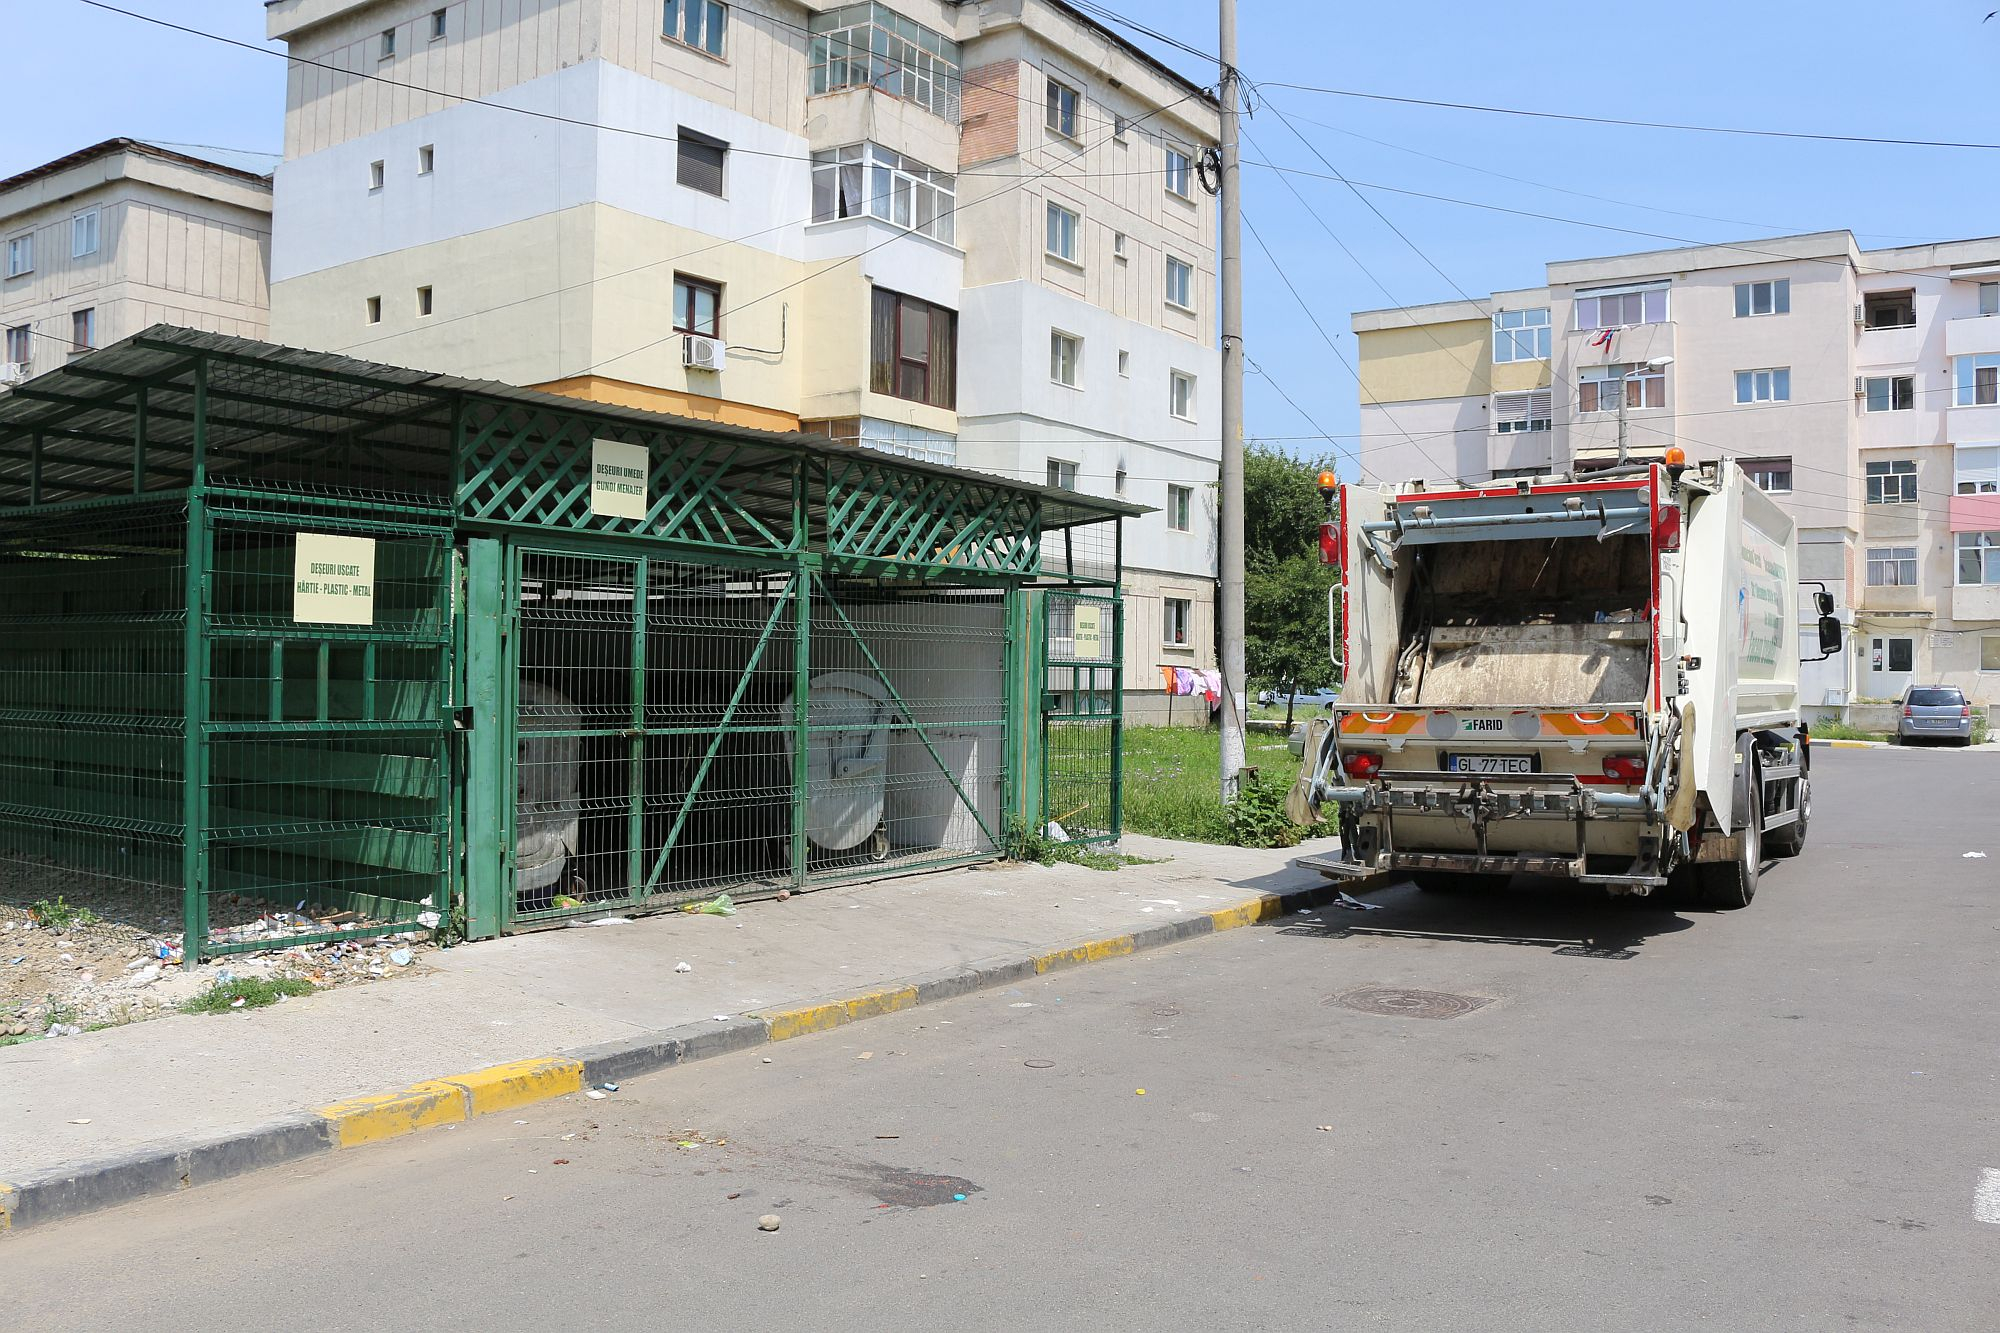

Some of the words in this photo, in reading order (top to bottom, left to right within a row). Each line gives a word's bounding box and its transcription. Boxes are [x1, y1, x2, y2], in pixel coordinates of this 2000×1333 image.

[624, 468, 643, 479] UMEDE
[597, 481, 616, 492] GUNOI
[617, 483, 642, 496] MENAJER
[337, 564, 360, 576] USCATE
[324, 583, 348, 595] PLASTIC
[353, 586, 371, 597] METAL
[1473, 719, 1503, 730] FARID
[1458, 758, 1476, 772] GL
[1481, 758, 1497, 772] 77
[1501, 759, 1528, 772] TEC
